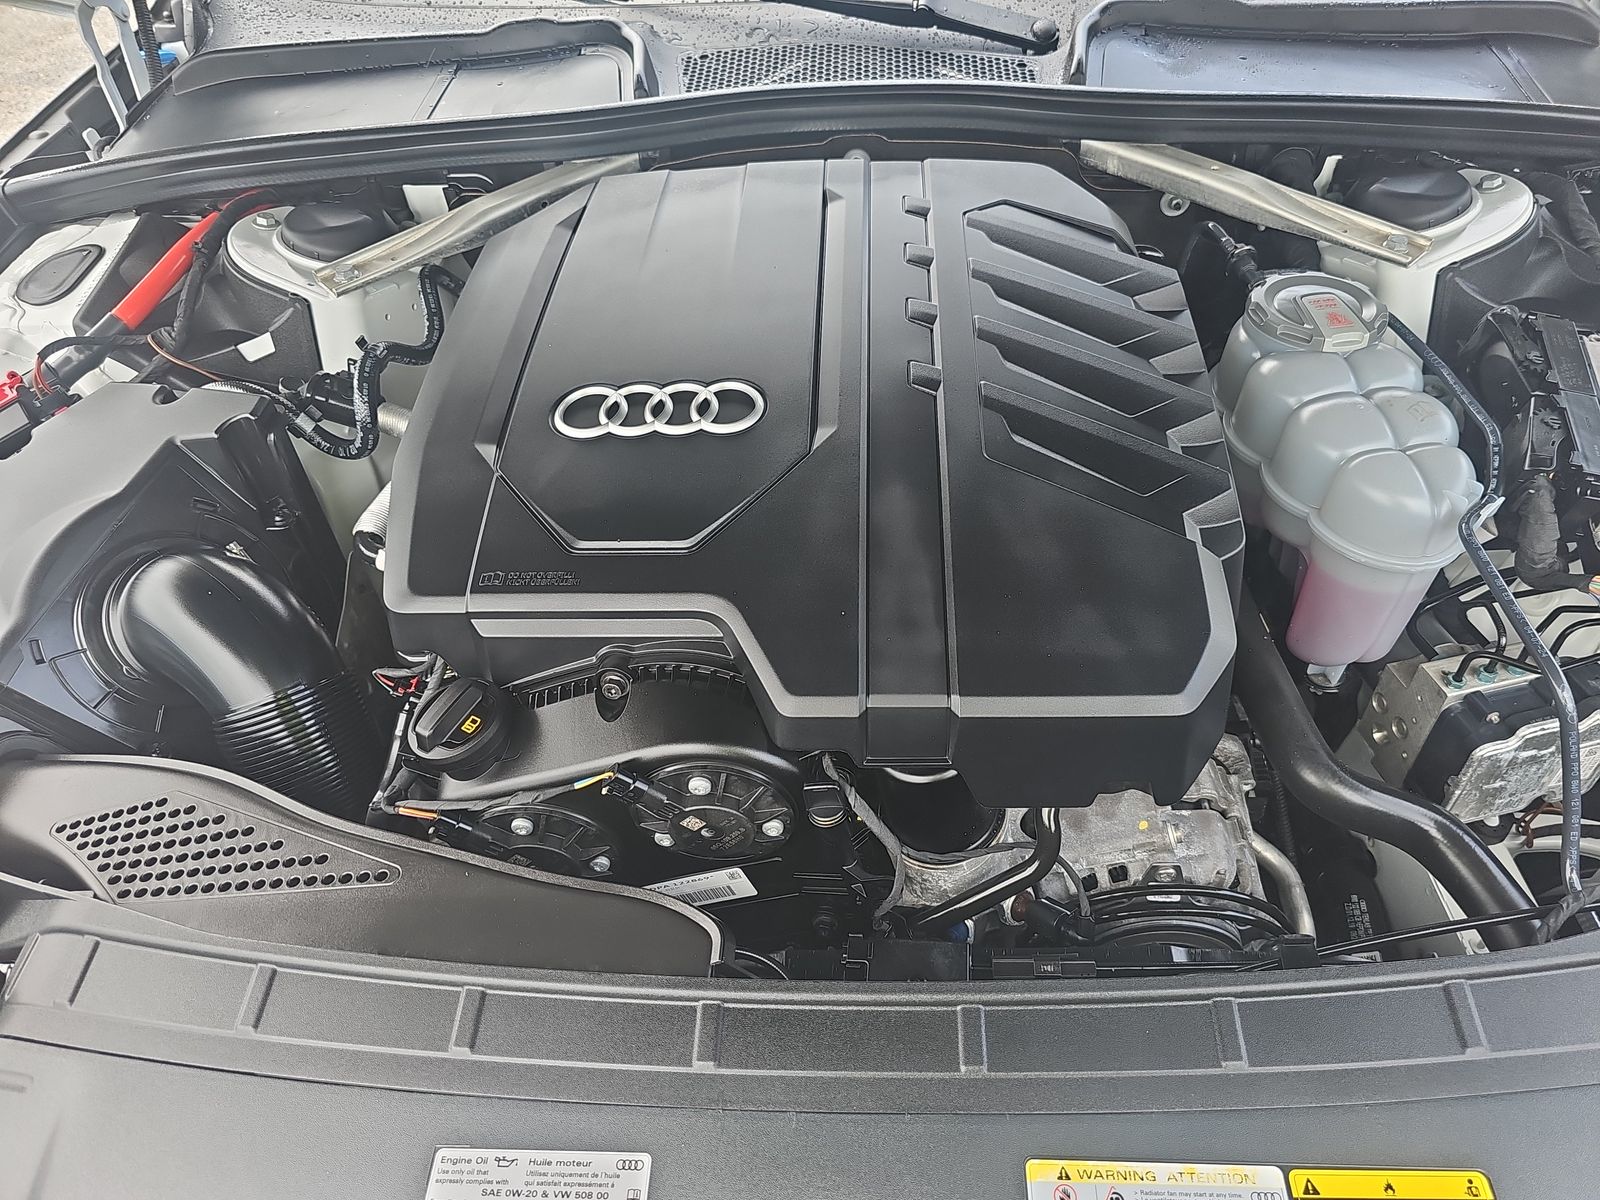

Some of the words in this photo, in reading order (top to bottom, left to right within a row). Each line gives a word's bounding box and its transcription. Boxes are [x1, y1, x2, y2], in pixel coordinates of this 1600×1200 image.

[1568, 730, 1579, 759] POLAND
[1570, 798, 1580, 811] 121
[1569, 831, 1579, 842] ED
[440, 1155, 473, 1166] Engine
[475, 1156, 489, 1165] Oil
[528, 1157, 553, 1166] Huile
[555, 1159, 593, 1168] moteur
[437, 1167, 450, 1175] Use
[450, 1168, 465, 1176] only
[476, 1168, 489, 1176] that
[525, 1169, 549, 1177] Utilisez
[550, 1170, 590, 1179] uniquement
[590, 1171, 599, 1179] de
[1077, 1168, 1157, 1182] WARNING
[1166, 1171, 1257, 1184] ATTENTION
[434, 1178, 464, 1186] expressly
[465, 1178, 494, 1186] complies
[480, 1188, 502, 1197] SAE
[505, 1189, 538, 1198] 0W-20
[541, 1190, 549, 1198] &
[553, 1190, 572, 1199] VW
[574, 1191, 594, 1199] 508
[596, 1191, 609, 1200] 00
[1178, 1190, 1192, 1198] may
